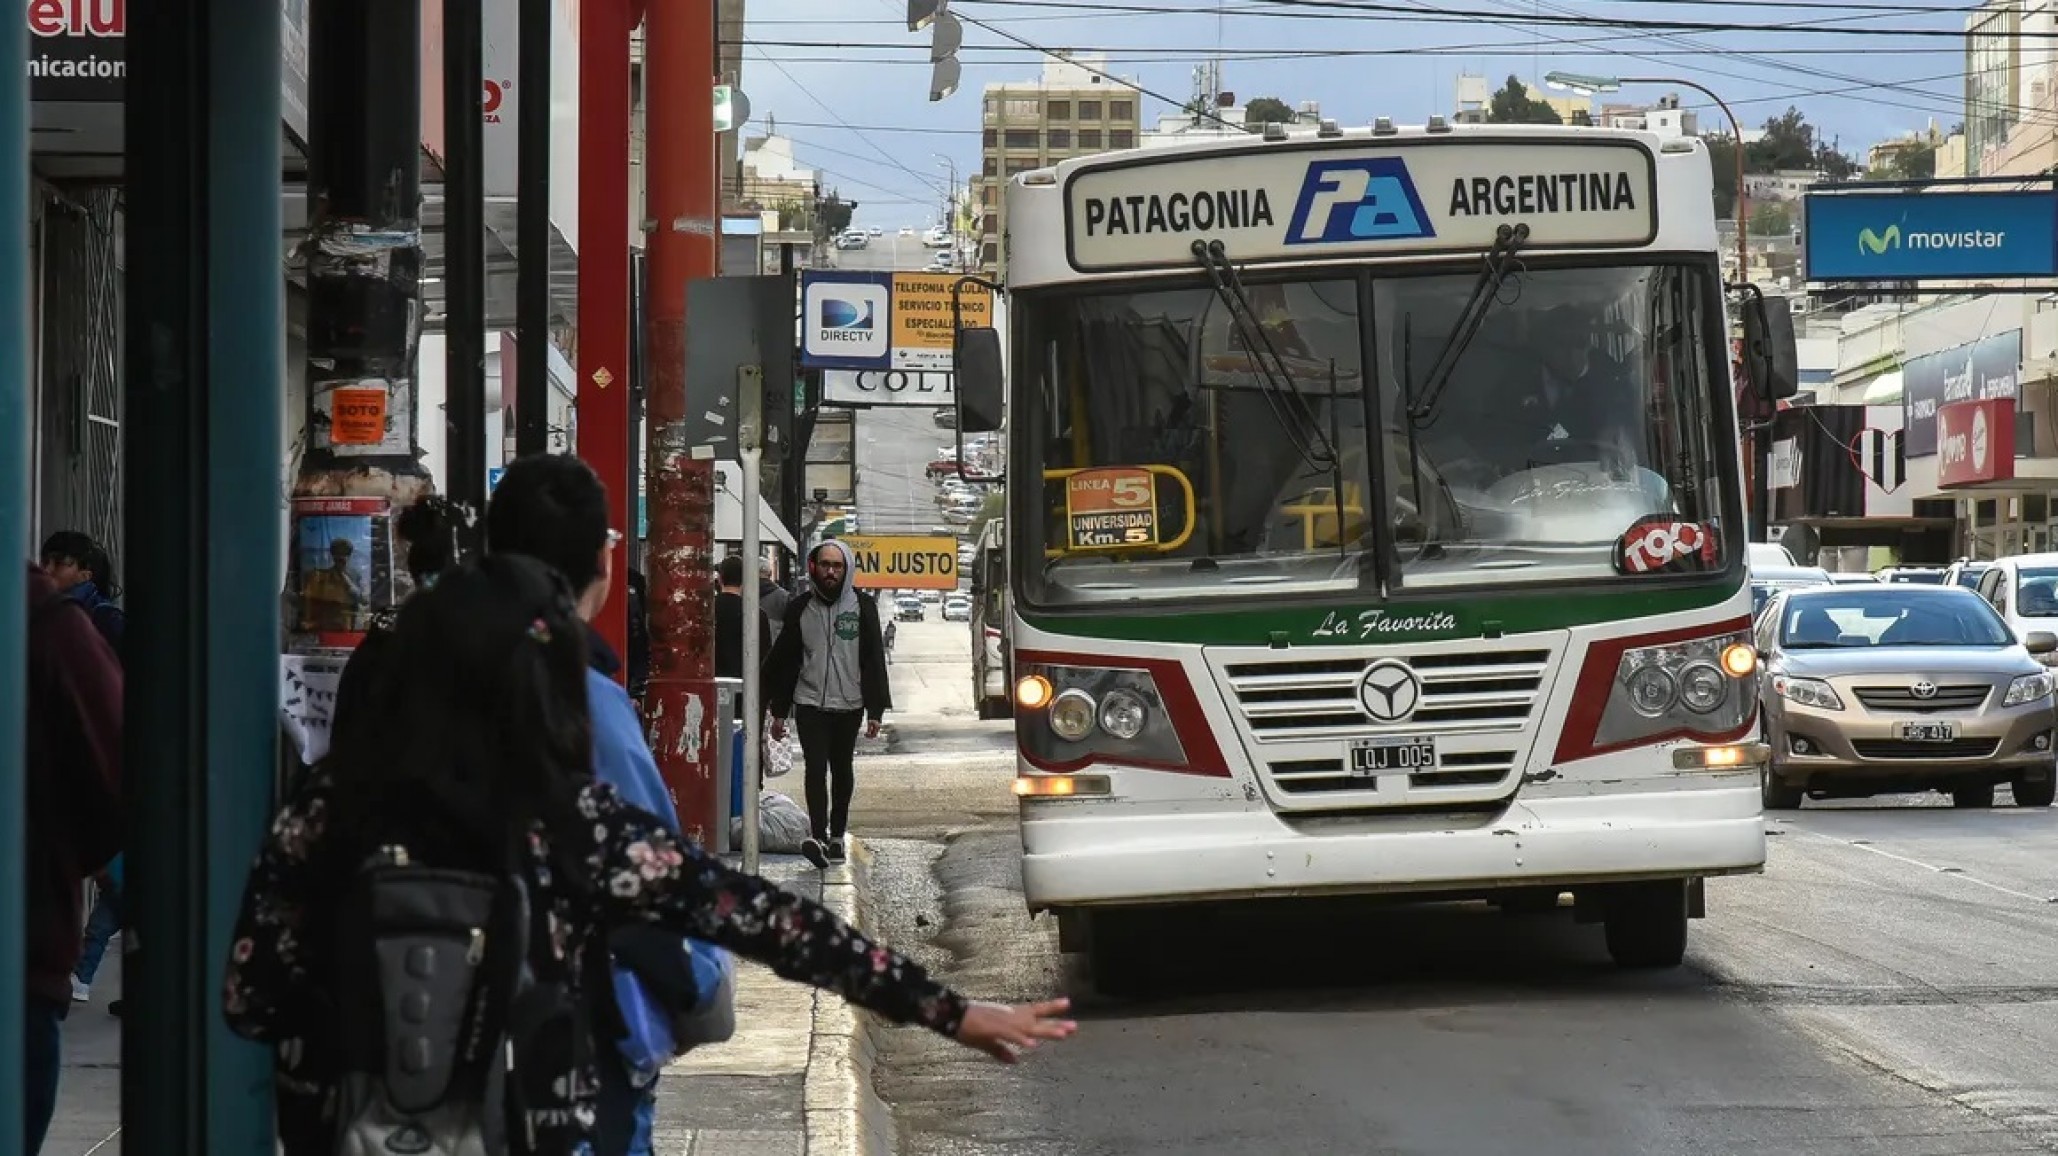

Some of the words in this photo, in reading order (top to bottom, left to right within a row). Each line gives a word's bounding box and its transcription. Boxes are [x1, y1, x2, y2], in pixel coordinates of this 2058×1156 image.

[1085, 188, 1274, 236] PATAGONIA
[1449, 172, 1635, 217] ARGENTINA
[1908, 230, 2005, 249] movistar
[895, 281, 945, 294] TELEFONIA
[898, 300, 941, 311] SERVICIO
[821, 330, 873, 342] DIRECTV
[1071, 479, 1111, 491] LINEA
[1112, 477, 1151, 506] 5
[1073, 513, 1153, 531] UNIVERSIDAD
[1079, 531, 1120, 545] Km.
[1124, 528, 1149, 542] 5
[886, 552, 953, 575] JUSTO
[1312, 611, 1349, 637] La
[1358, 609, 1456, 639] Favorita
[1399, 745, 1433, 768] 005
